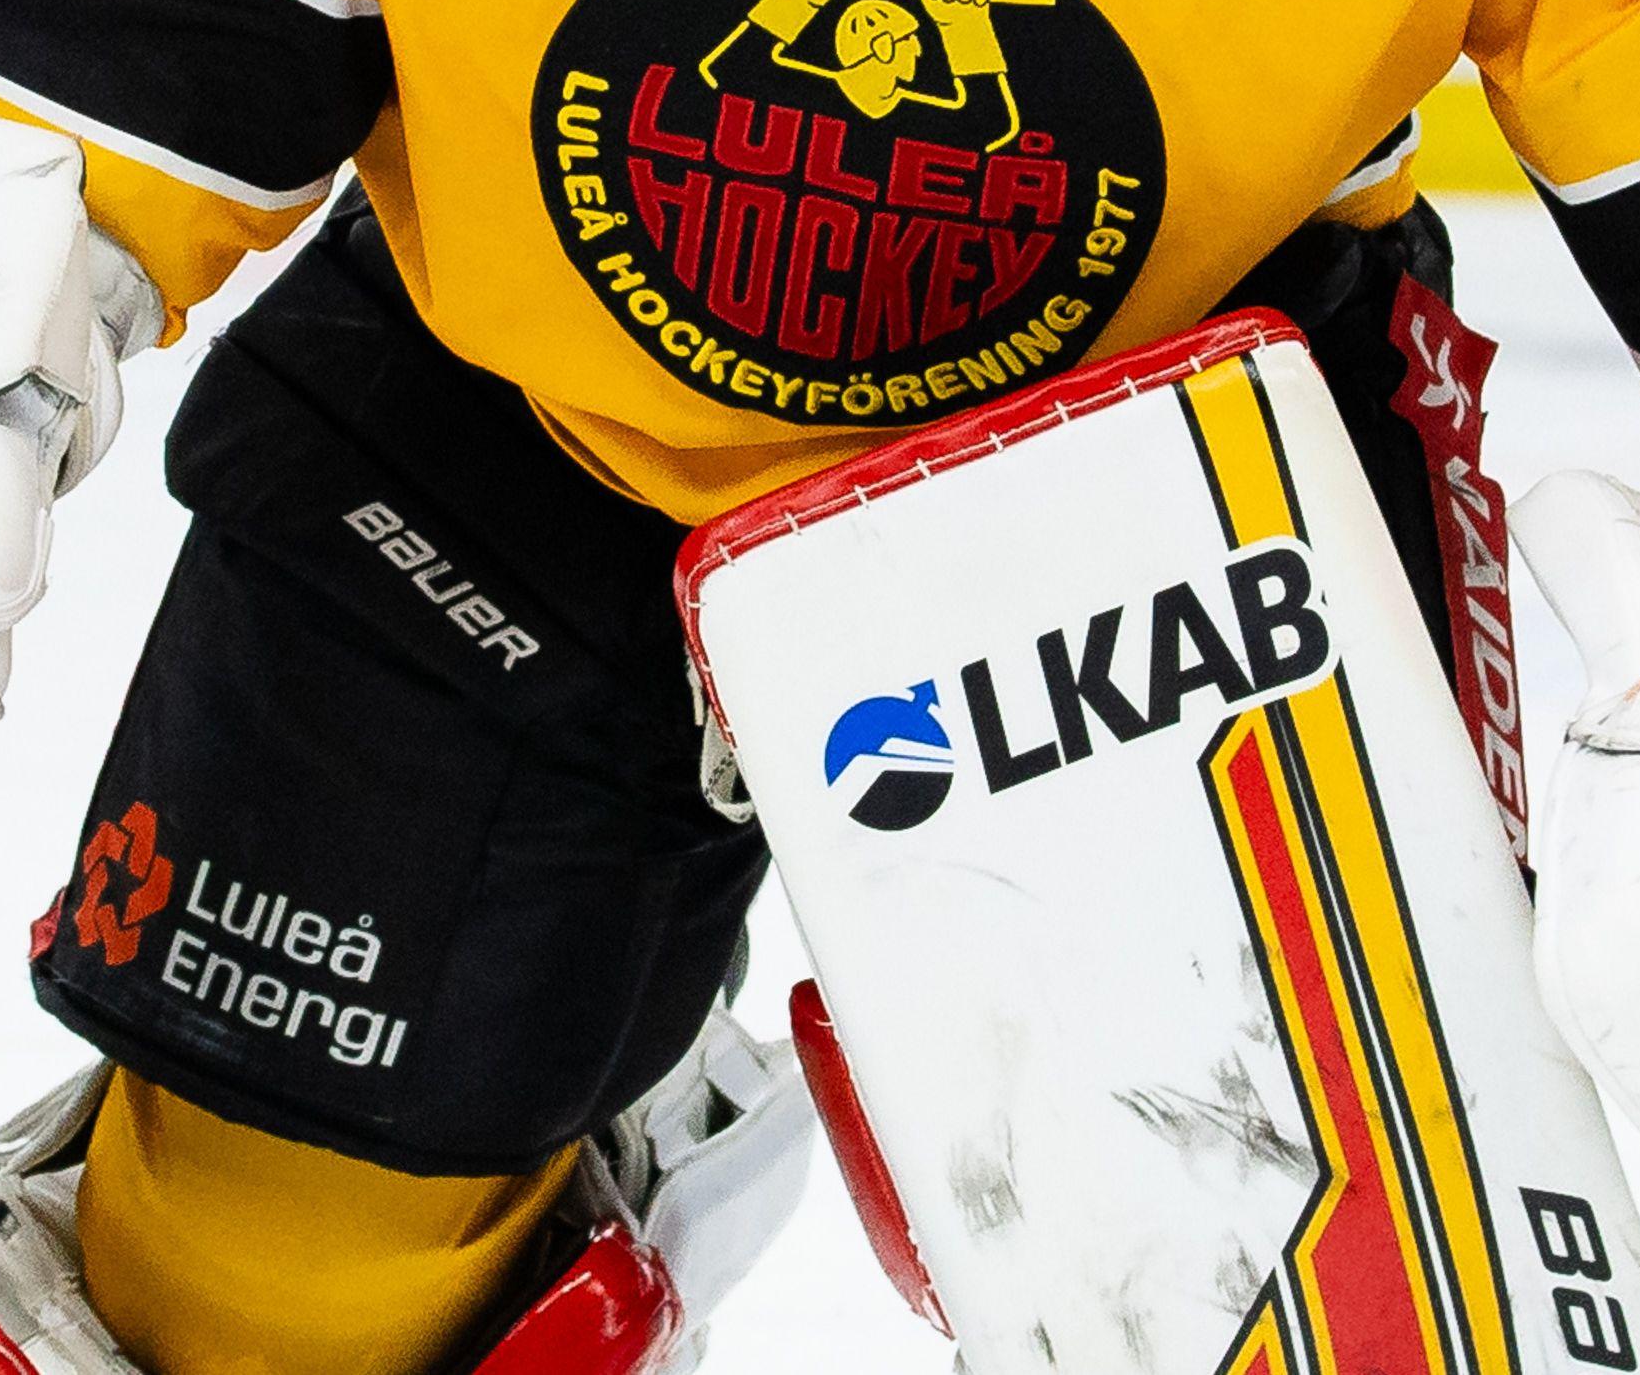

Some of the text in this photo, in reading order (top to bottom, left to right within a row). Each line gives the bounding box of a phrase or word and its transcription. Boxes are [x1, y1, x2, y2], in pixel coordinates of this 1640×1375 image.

[628, 63, 1068, 225] LULEÅ
[556, 70, 1141, 416] LULEÅ HOCKEYFÖRENING 1977
[628, 157, 1056, 361] HOCKEY
[960, 546, 1330, 795] LKAB
[161, 928, 407, 1068] Energi
[184, 859, 384, 983] Luleå
